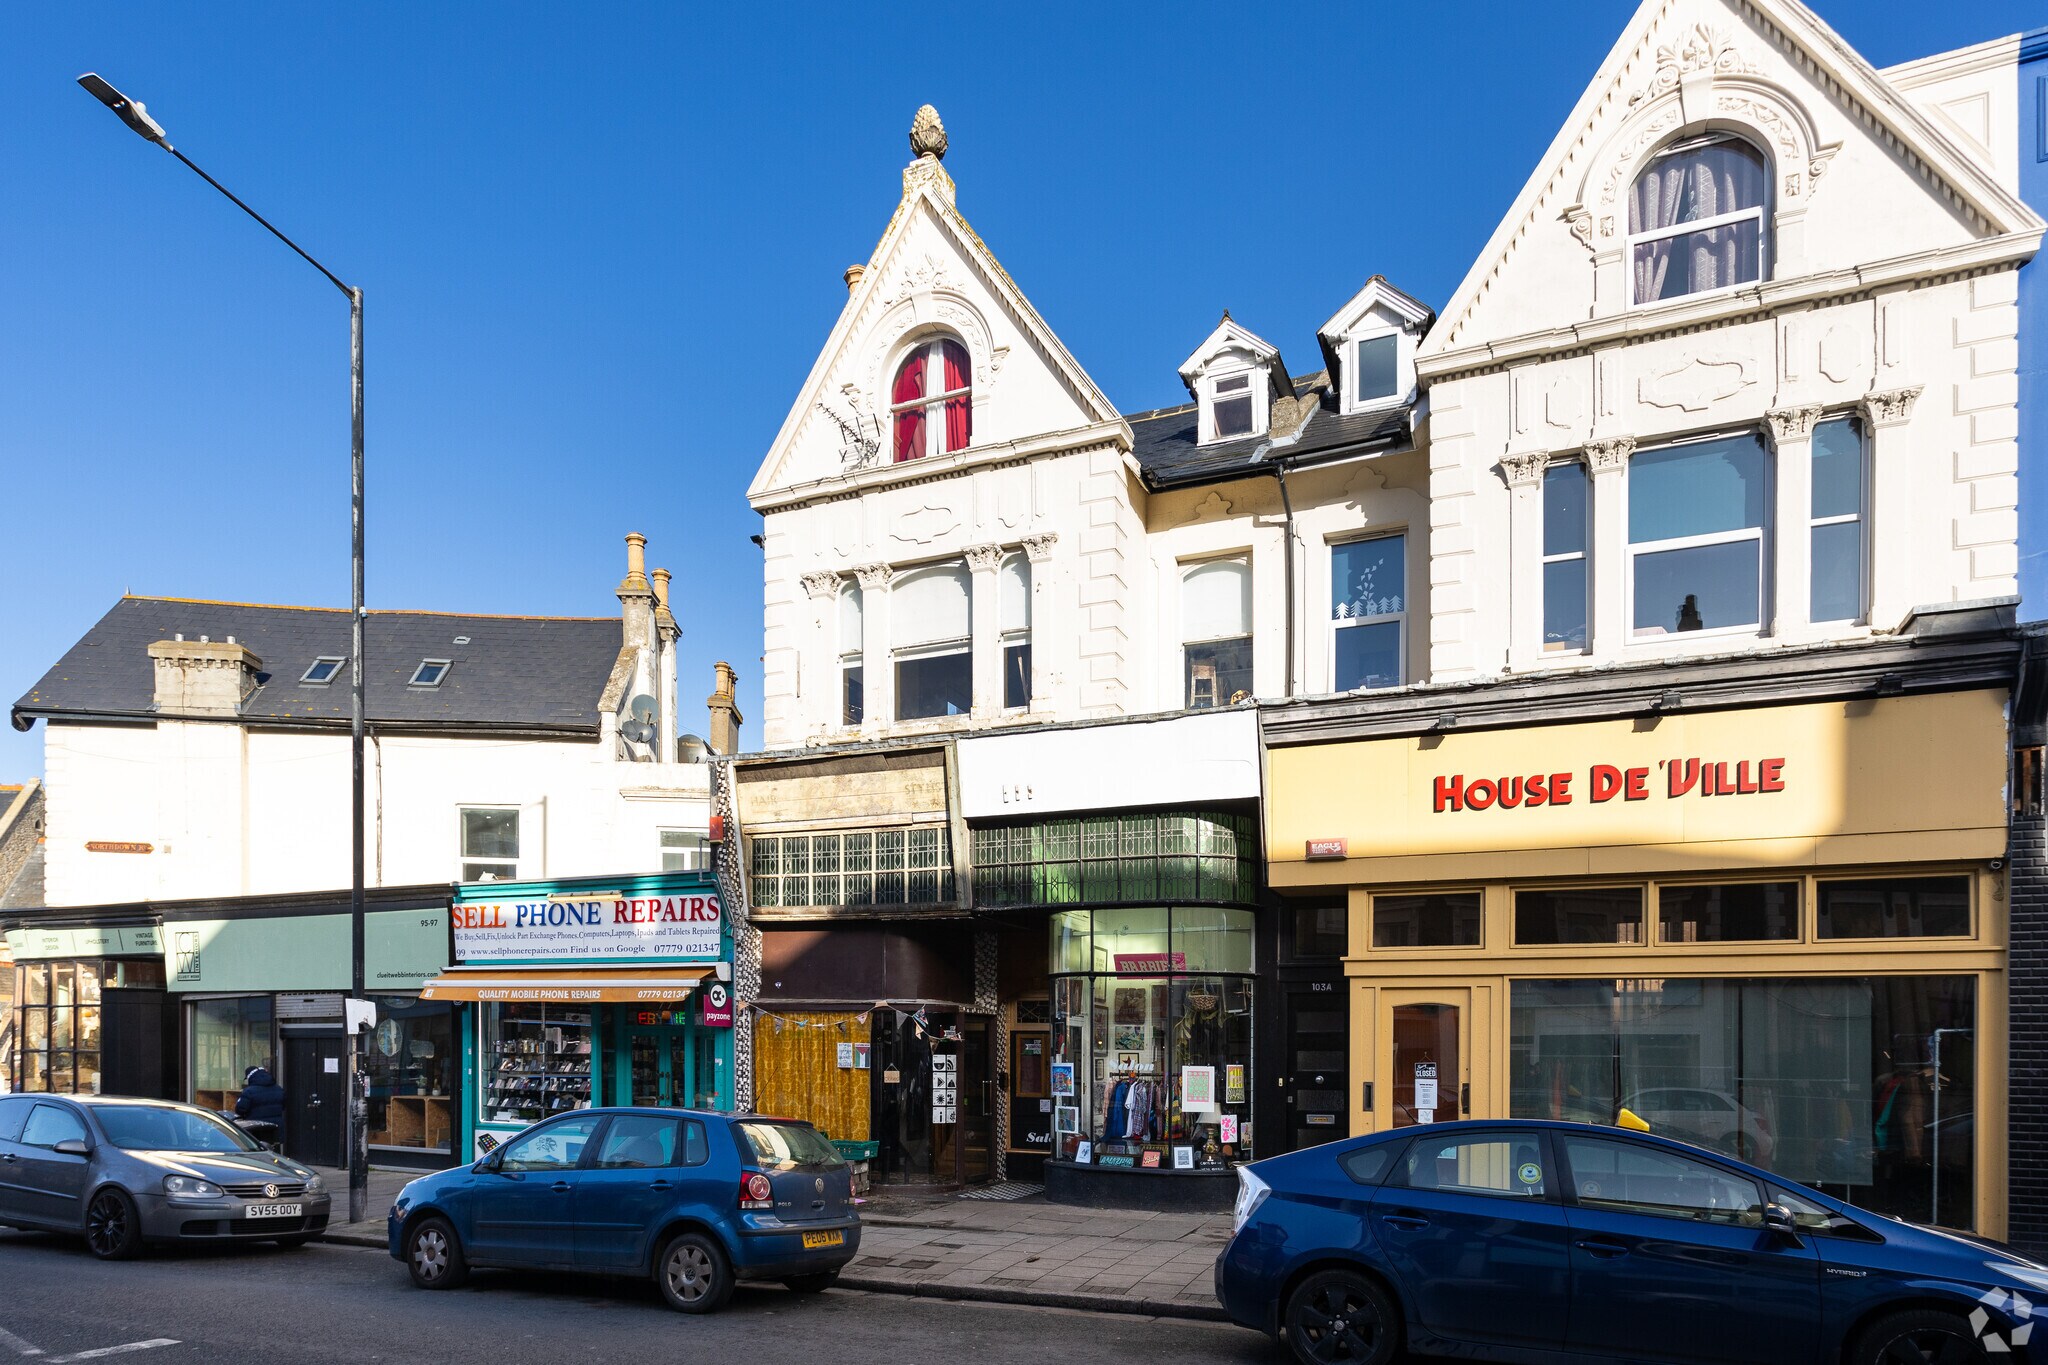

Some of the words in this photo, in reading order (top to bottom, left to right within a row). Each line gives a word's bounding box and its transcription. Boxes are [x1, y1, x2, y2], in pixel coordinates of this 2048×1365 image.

[1433, 772, 1573, 814] HOUSE
[90, 843, 136, 851] NORTHDOWN
[452, 906, 507, 929] SELL
[515, 902, 602, 927] PHONE
[613, 896, 720, 923] REPAIRS
[420, 919, 438, 927] 95-97
[135, 932, 154, 940] VINTAGE
[517, 932, 529, 940] Part
[529, 931, 557, 941] Exchange
[655, 928, 667, 936] and
[668, 927, 691, 936] Tablets
[692, 926, 720, 936] Repaired
[456, 948, 466, 957] 99
[470, 946, 568, 956] www.sellphonerepairs.com
[570, 945, 589, 953] Find
[616, 944, 646, 955] Google
[654, 943, 683, 954] 07779
[686, 943, 720, 953] 021347
[377, 971, 438, 979] clueitwebbinteriors.com
[1312, 982, 1332, 991] 103A
[478, 989, 509, 999] QUALITY
[511, 989, 540, 999] MOBILE
[540, 989, 569, 999] PHONE
[571, 989, 601, 999] REPAIRS
[637, 990, 661, 999] 07779
[706, 1012, 731, 1022] payzone
[1109, 1059, 1154, 1071] Salon
[251, 1205, 278, 1216] SV55
[806, 1231, 827, 1245] PE06
[1826, 1268, 1861, 1277] HYBRID
